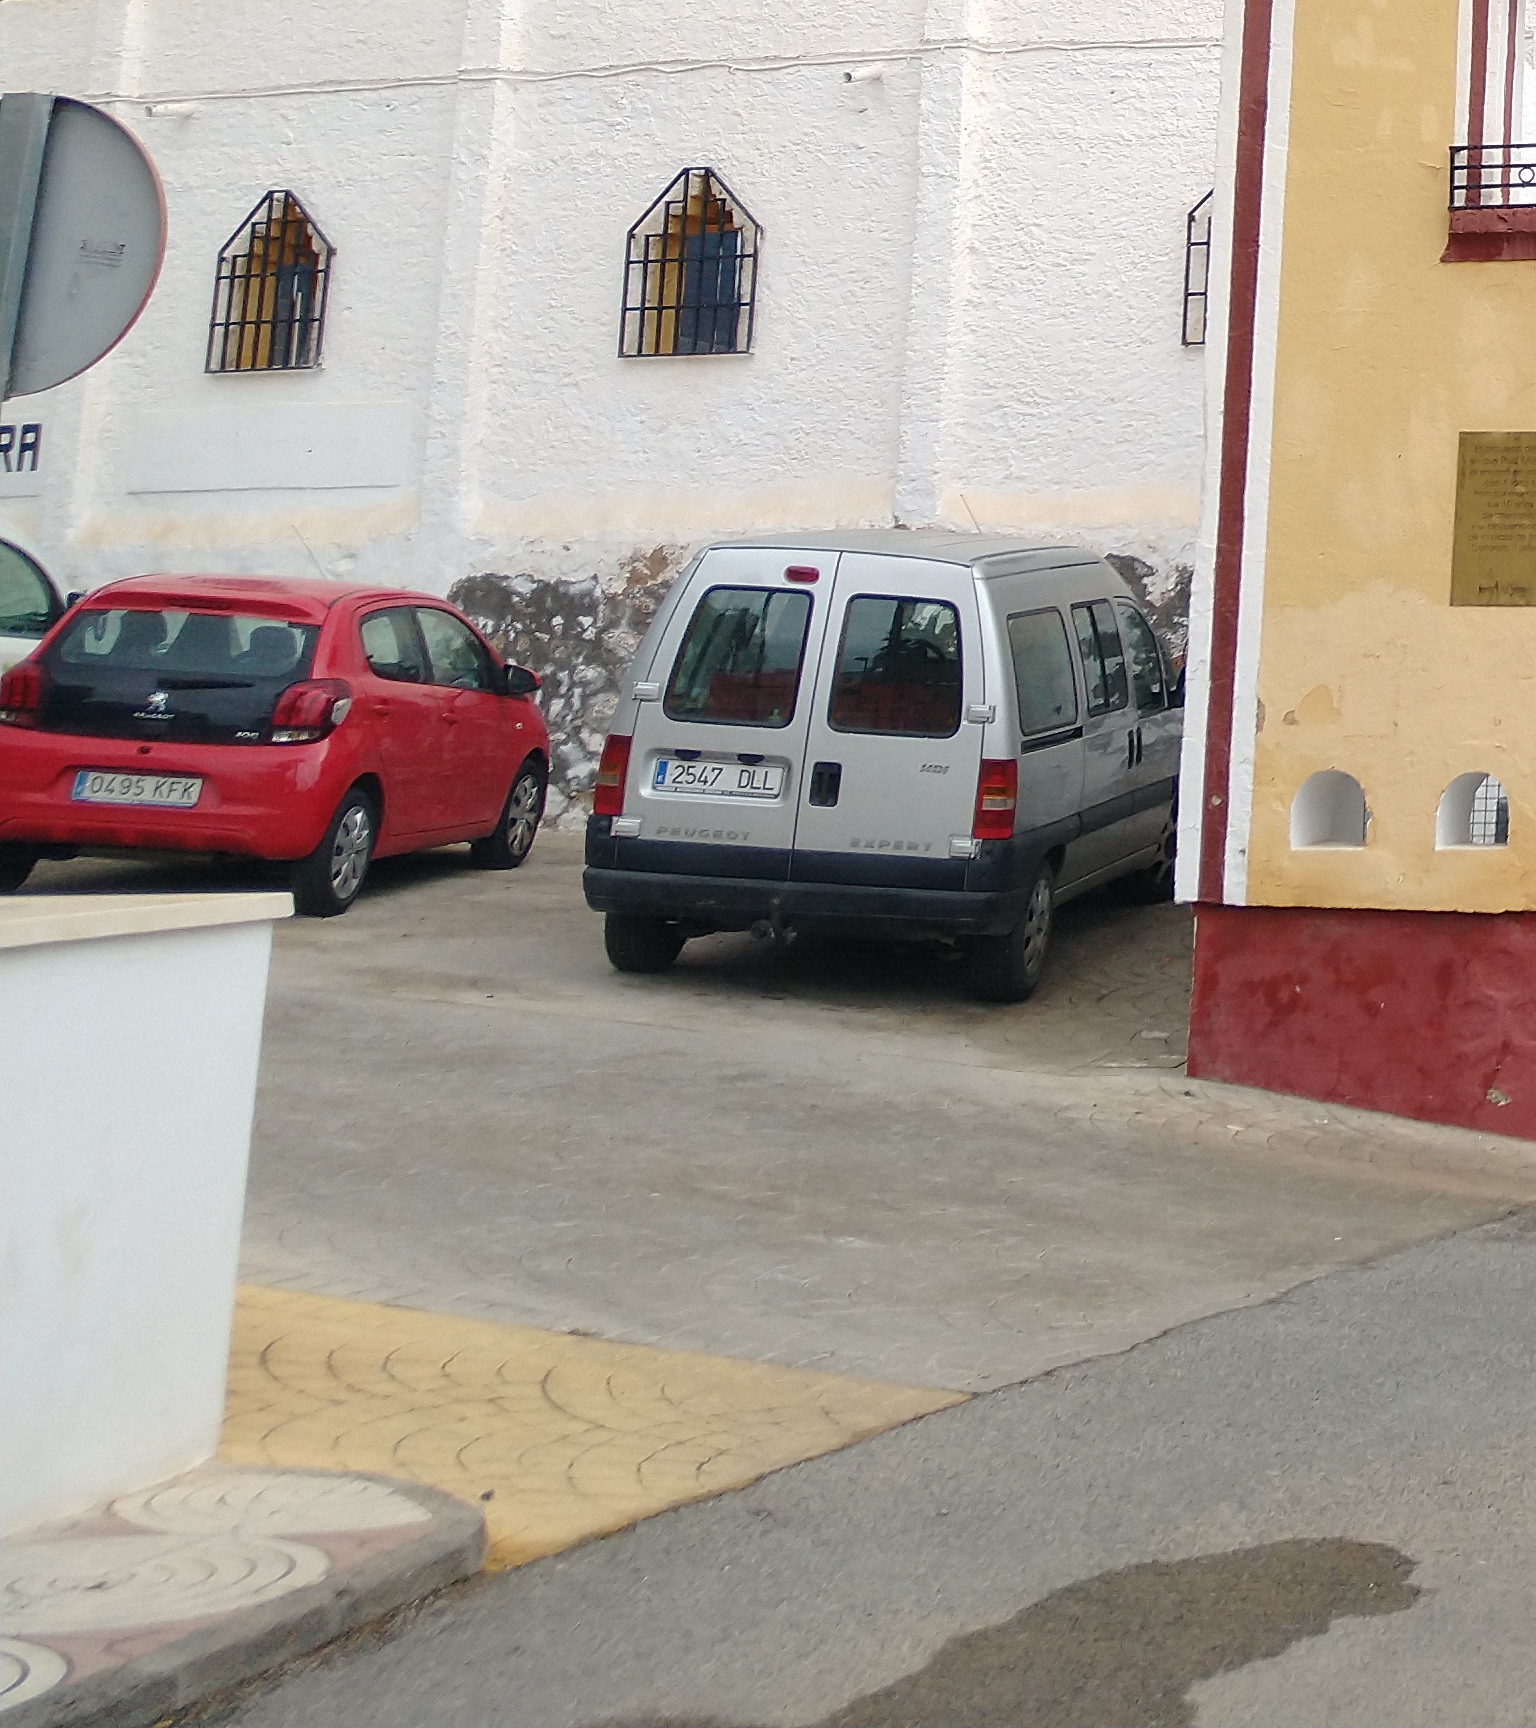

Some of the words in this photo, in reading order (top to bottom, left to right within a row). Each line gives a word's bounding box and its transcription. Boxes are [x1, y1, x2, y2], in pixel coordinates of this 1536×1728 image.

[90, 775, 146, 797] 0495
[152, 779, 198, 801] KFK
[672, 765, 723, 787] 2547
[737, 769, 775, 791] DLL
[656, 826, 751, 841] PEUGEOT
